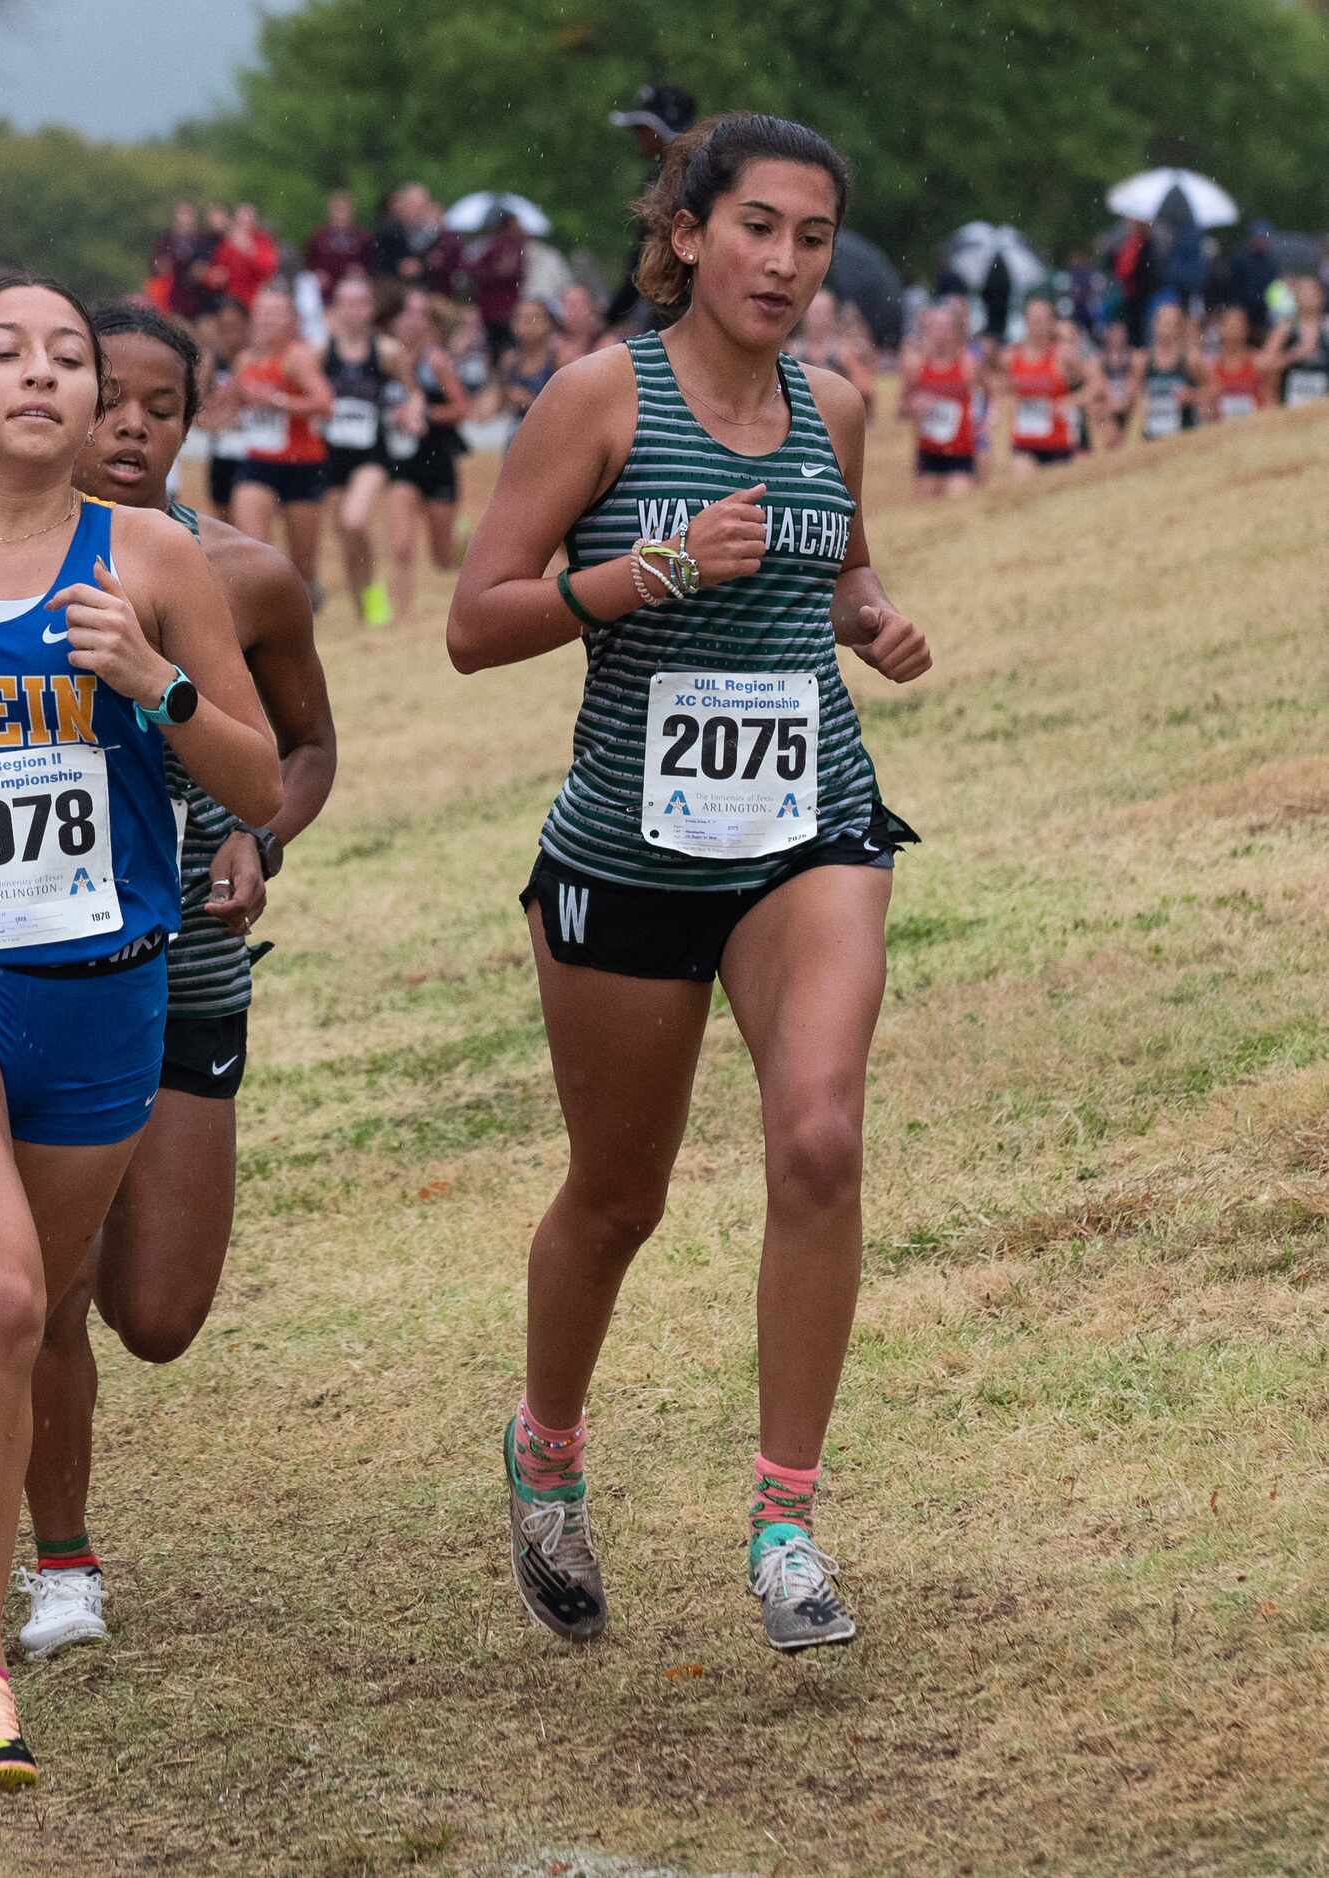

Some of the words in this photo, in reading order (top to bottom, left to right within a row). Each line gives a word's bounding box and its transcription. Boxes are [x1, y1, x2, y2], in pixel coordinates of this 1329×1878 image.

[694, 679, 719, 690] UIL
[725, 679, 774, 694] Region
[777, 680, 785, 691] II
[675, 694, 697, 706] XC
[702, 695, 800, 711] Championship
[660, 714, 808, 781] 2075
[51, 752, 62, 765] II
[702, 802, 767, 813] ARLINGTON
[91, 911, 111, 923] 1978
[559, 883, 589, 944] W
